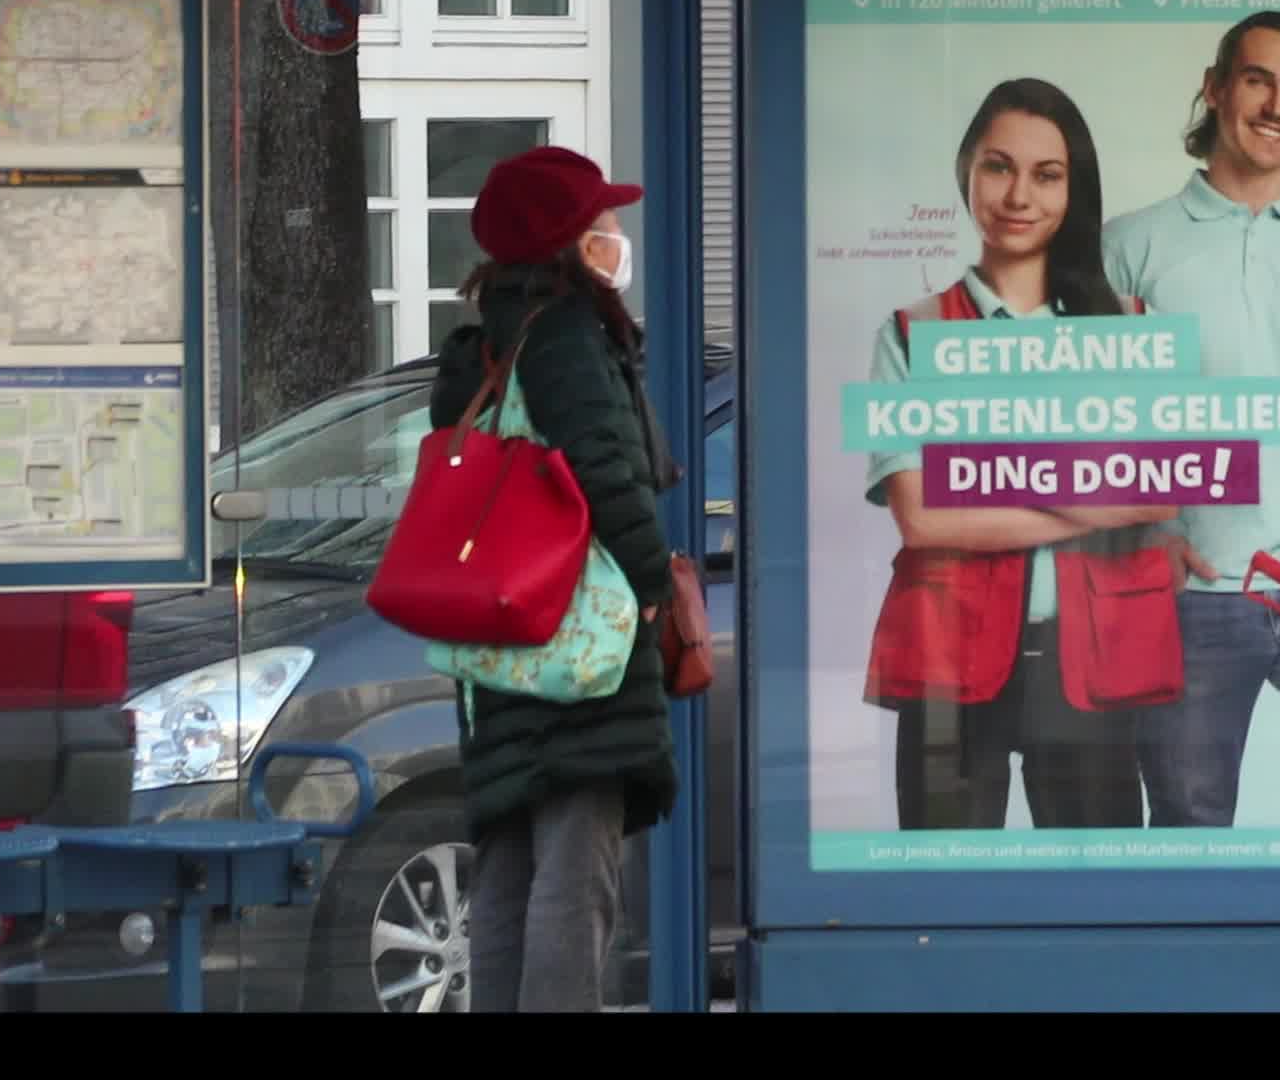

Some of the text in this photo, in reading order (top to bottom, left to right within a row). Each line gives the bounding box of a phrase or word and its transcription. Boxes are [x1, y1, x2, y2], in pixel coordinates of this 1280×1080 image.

[907, 204, 956, 221] Jenni
[934, 326, 1176, 375] GETRÄNKE
[867, 396, 1138, 437] KOSTENLOS
[948, 448, 1232, 498] DING DONG!
